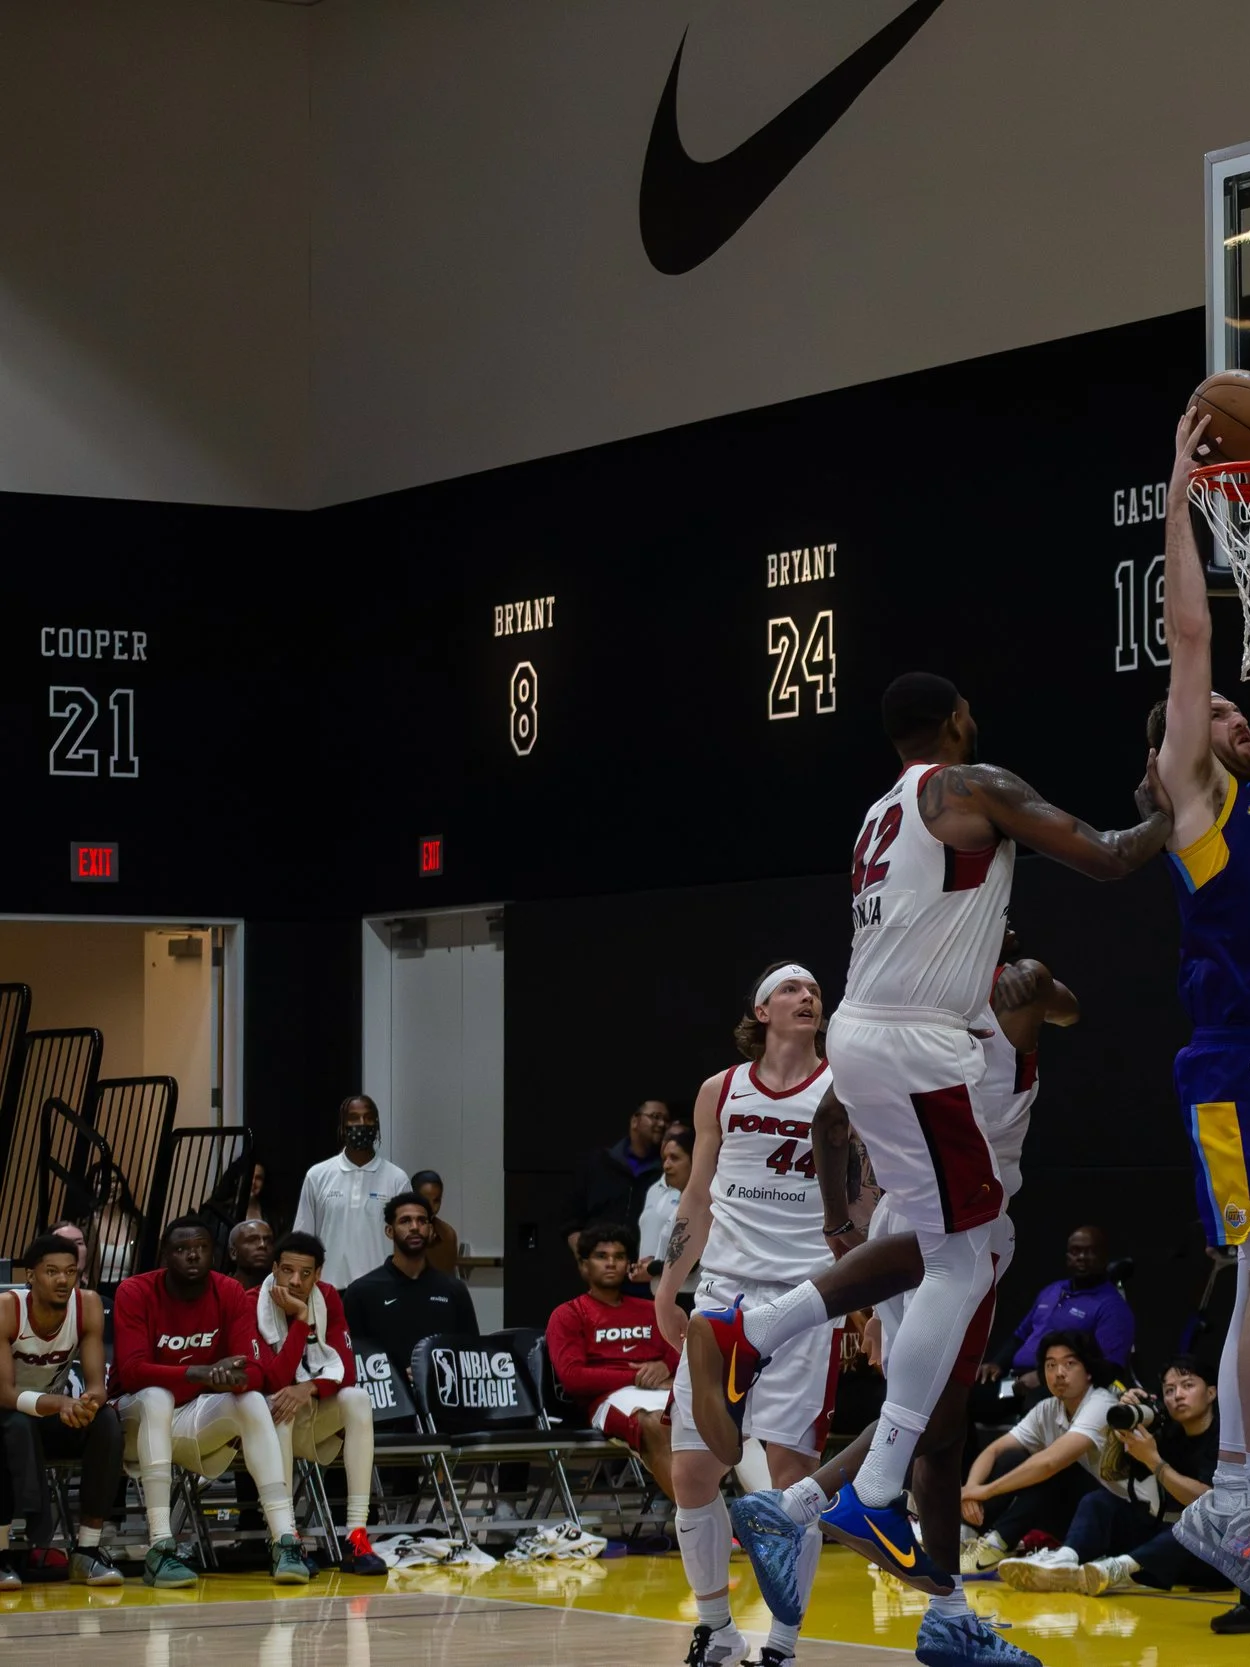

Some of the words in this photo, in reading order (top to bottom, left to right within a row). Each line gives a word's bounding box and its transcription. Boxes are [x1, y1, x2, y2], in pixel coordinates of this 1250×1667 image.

[1113, 481, 1167, 527] GASO
[766, 542, 838, 588] BRYANT
[493, 596, 556, 637] BRYANT
[40, 626, 148, 661] COOPER
[767, 609, 837, 720] 24
[510, 660, 538, 757] 8
[48, 685, 139, 778] 21
[77, 847, 112, 877] EXIT
[423, 841, 441, 872] EXIT
[727, 1114, 813, 1139] FORCE
[766, 1139, 818, 1179] 44
[738, 1186, 806, 1203] Robinhood
[595, 1325, 653, 1343] FORCE
[459, 1351, 493, 1379] NBA
[462, 1378, 518, 1408] LEAGUE
